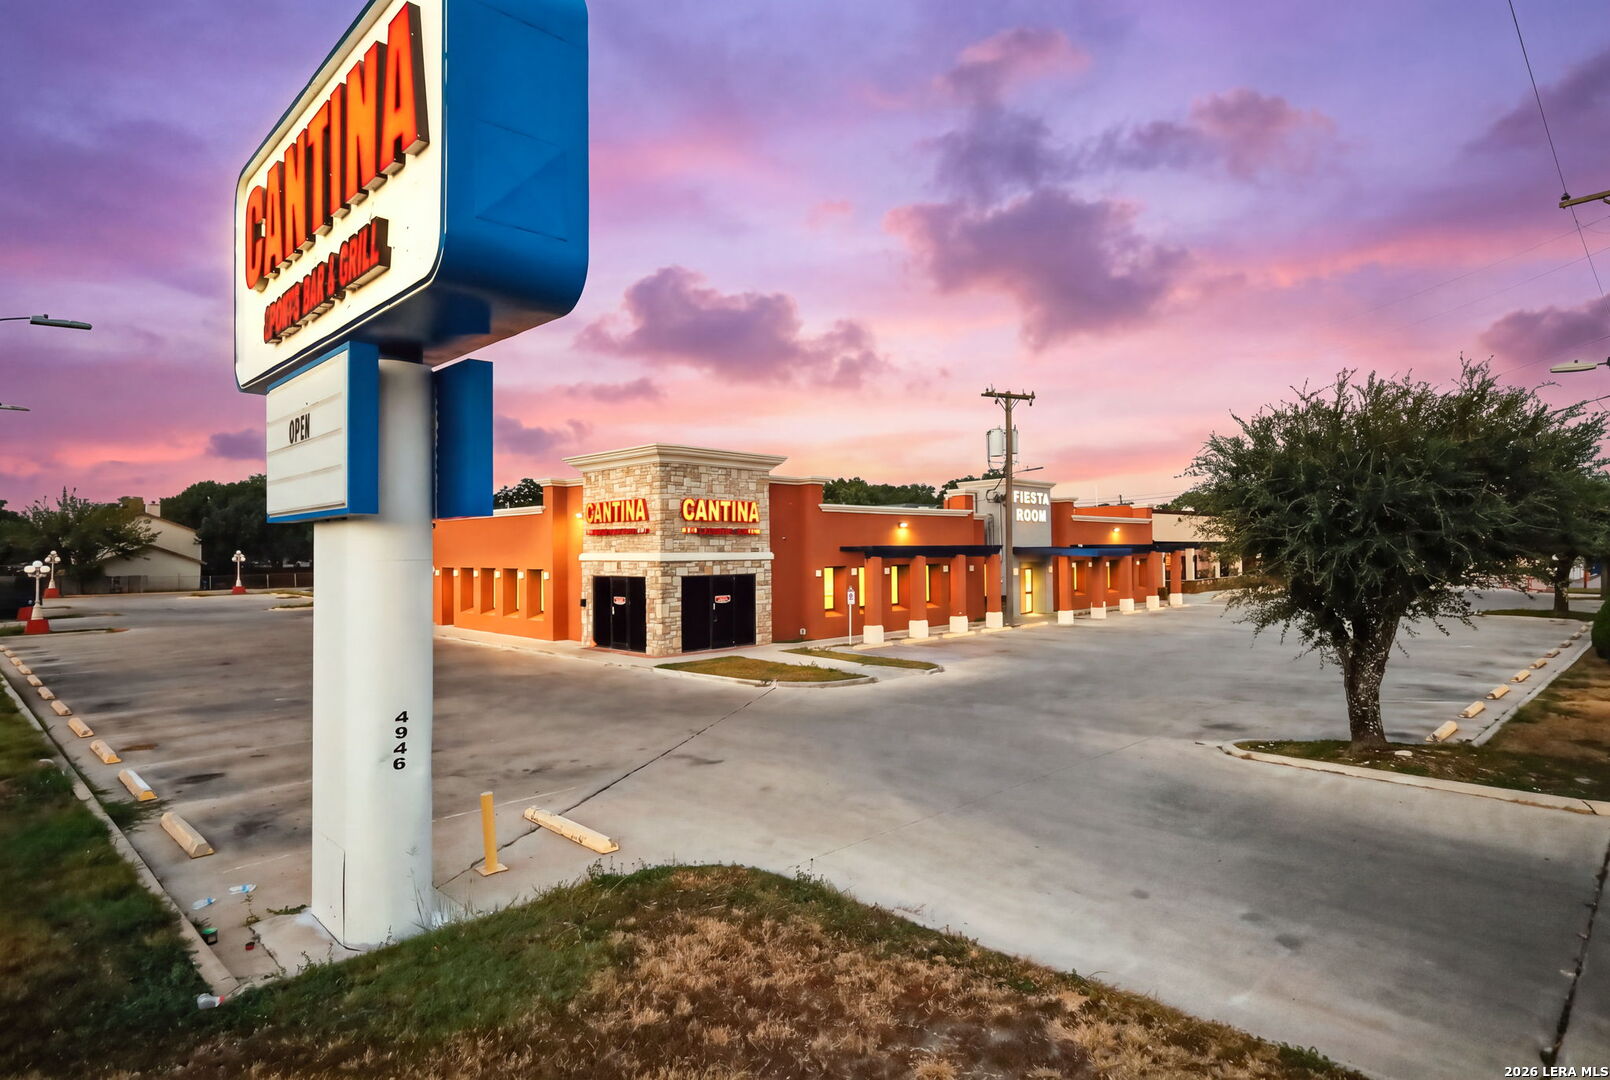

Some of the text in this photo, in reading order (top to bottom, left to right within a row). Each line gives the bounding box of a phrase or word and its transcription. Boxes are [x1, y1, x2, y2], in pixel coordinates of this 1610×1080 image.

[246, 1, 421, 290] CANTINA
[303, 262, 328, 318] BAR
[327, 252, 339, 297] &
[340, 219, 382, 289] GRILL
[289, 412, 311, 445] OPEN
[586, 498, 648, 524] CANTINA
[682, 498, 760, 523] CANTINA
[1013, 490, 1049, 505] FIESTA
[1016, 508, 1047, 522] ROOM
[393, 710, 409, 770] 4946
